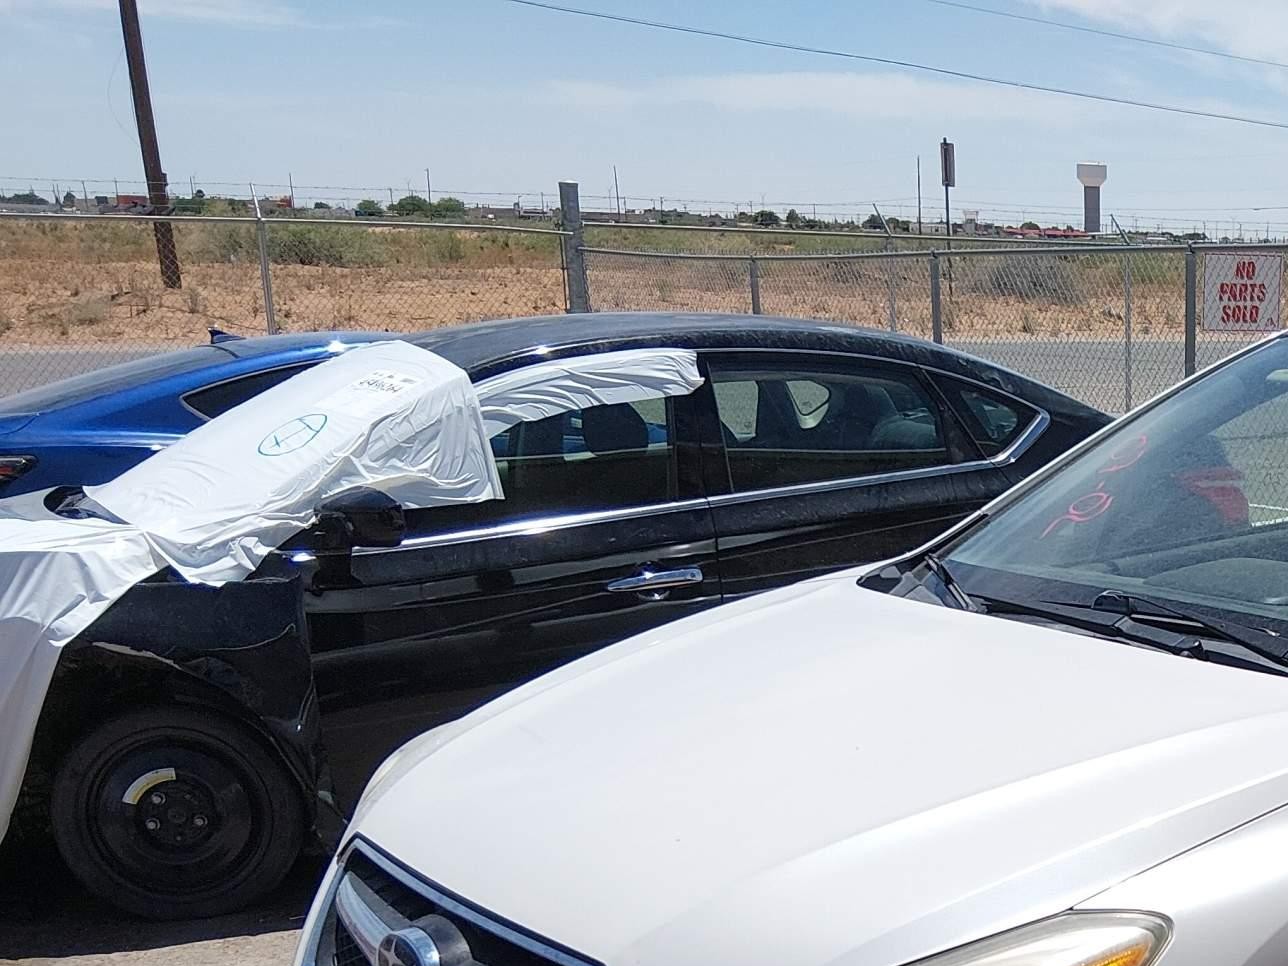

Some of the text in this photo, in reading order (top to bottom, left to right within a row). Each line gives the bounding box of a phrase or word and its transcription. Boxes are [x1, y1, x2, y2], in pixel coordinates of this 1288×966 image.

[1235, 261, 1256, 280] NO
[1219, 283, 1267, 302] PARTS
[1221, 304, 1260, 325] SOLD
